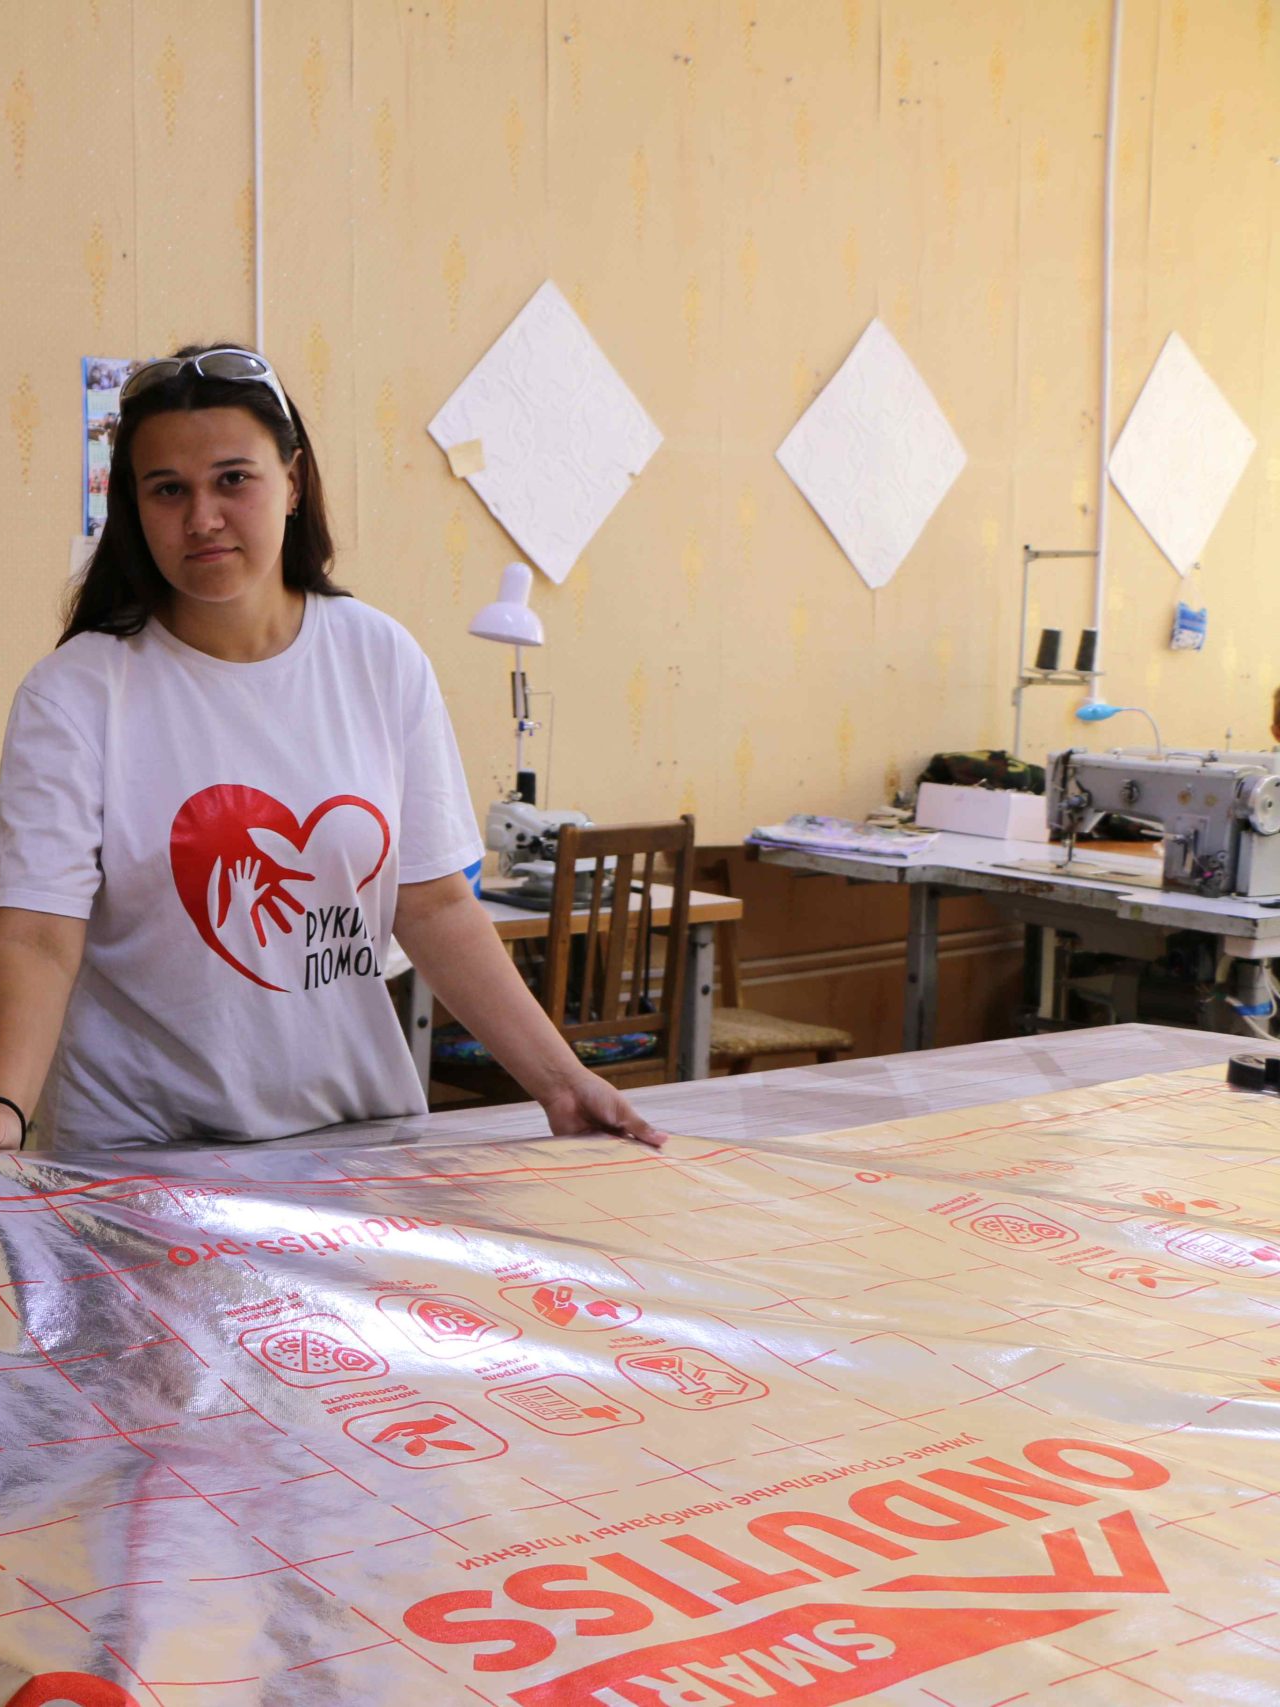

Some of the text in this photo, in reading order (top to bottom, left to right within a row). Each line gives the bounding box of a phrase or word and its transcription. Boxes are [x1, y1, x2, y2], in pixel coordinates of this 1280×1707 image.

[306, 905, 368, 948] РУКИ
[304, 943, 382, 991] ПОМО
[433, 1313, 475, 1332] 30
[481, 1363, 540, 1382] контроль
[320, 1384, 409, 1405] безопасность
[324, 1389, 421, 1415] экологическая
[455, 1432, 984, 1571] умные строительные мембраны и плёнки
[402, 1438, 1170, 1672] ONDUTISS
